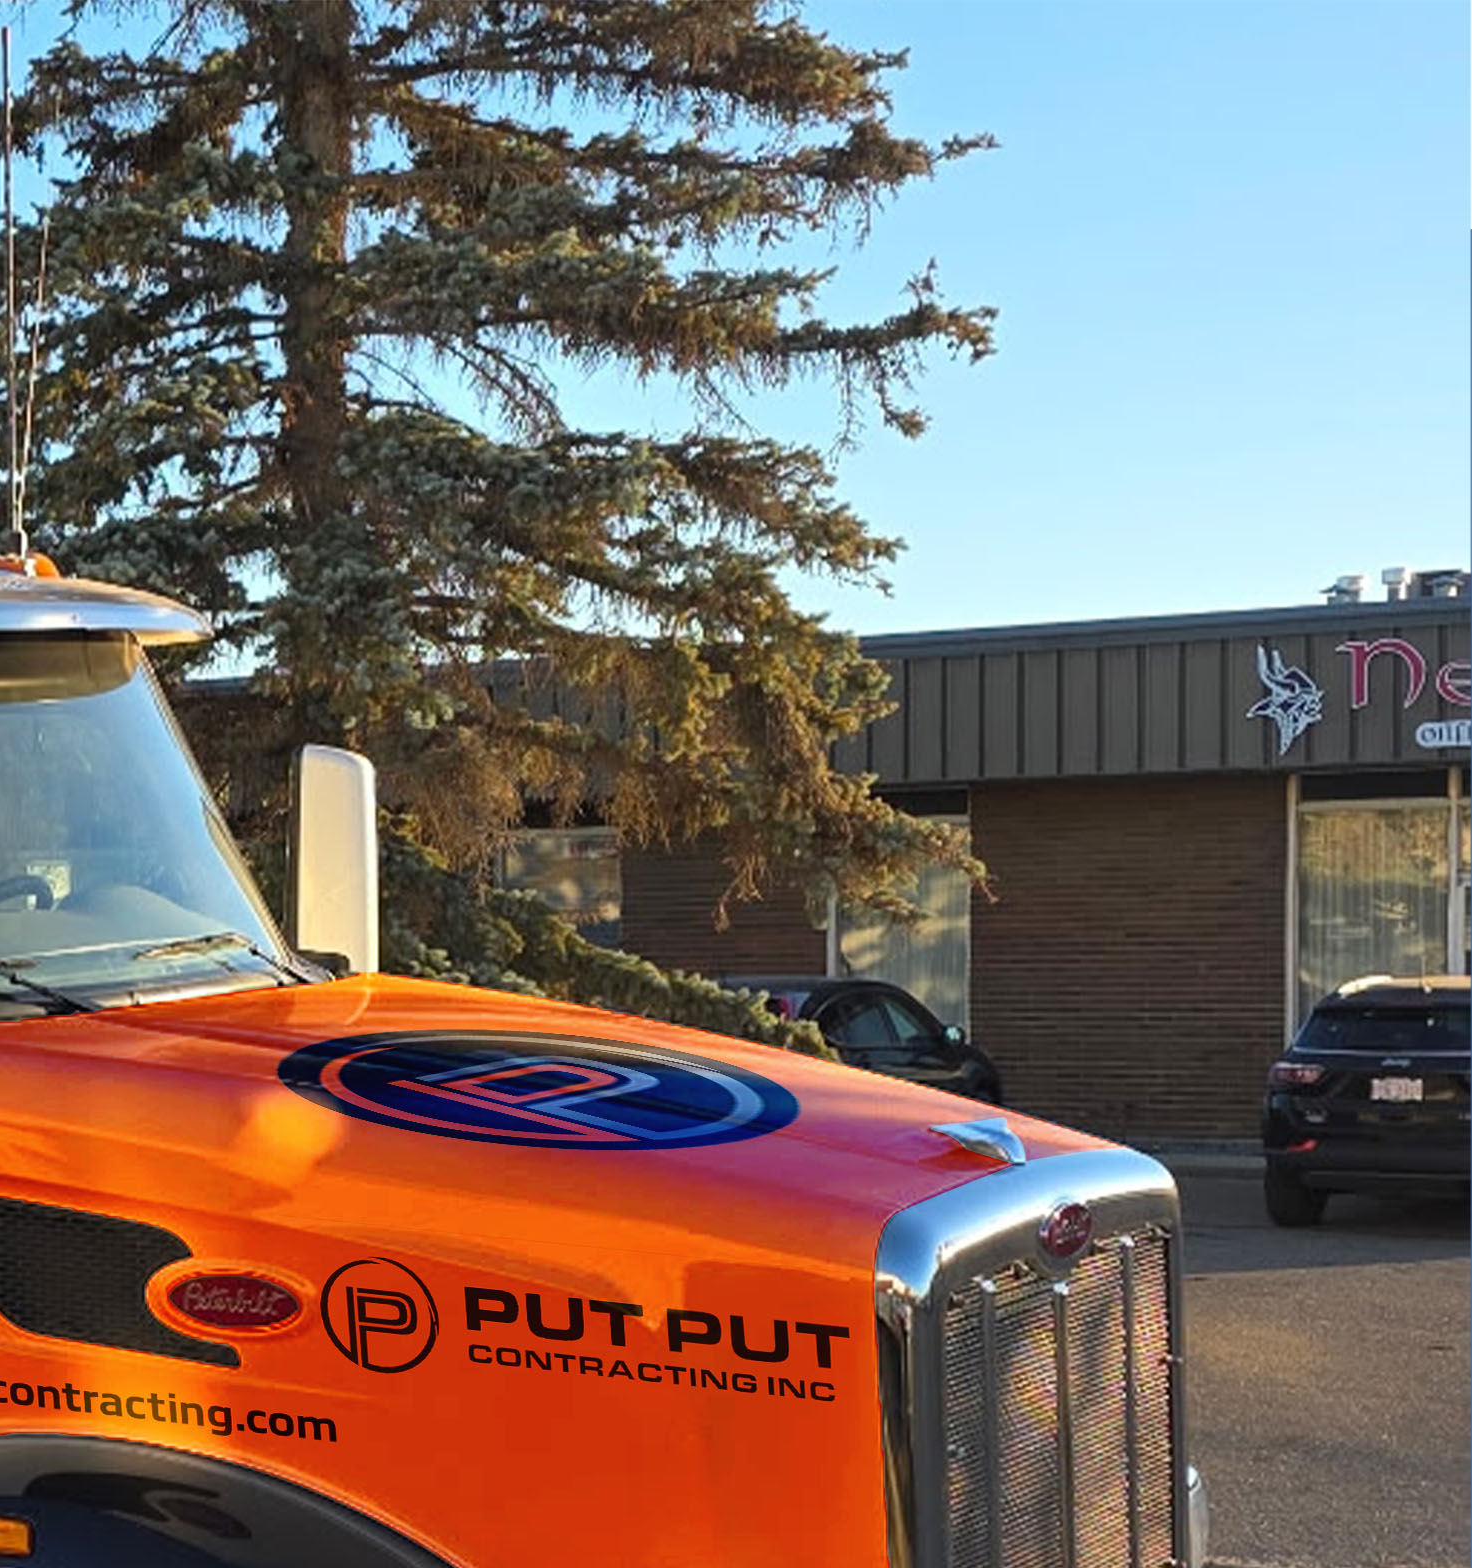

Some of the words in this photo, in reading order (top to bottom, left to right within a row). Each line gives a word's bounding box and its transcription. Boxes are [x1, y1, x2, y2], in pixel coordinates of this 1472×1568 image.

[184, 1283, 286, 1316] Peterbilt
[465, 1286, 642, 1343] PUT
[667, 1311, 850, 1369] PUT
[467, 1344, 759, 1395] CONTRACTING
[767, 1376, 836, 1403] INC
